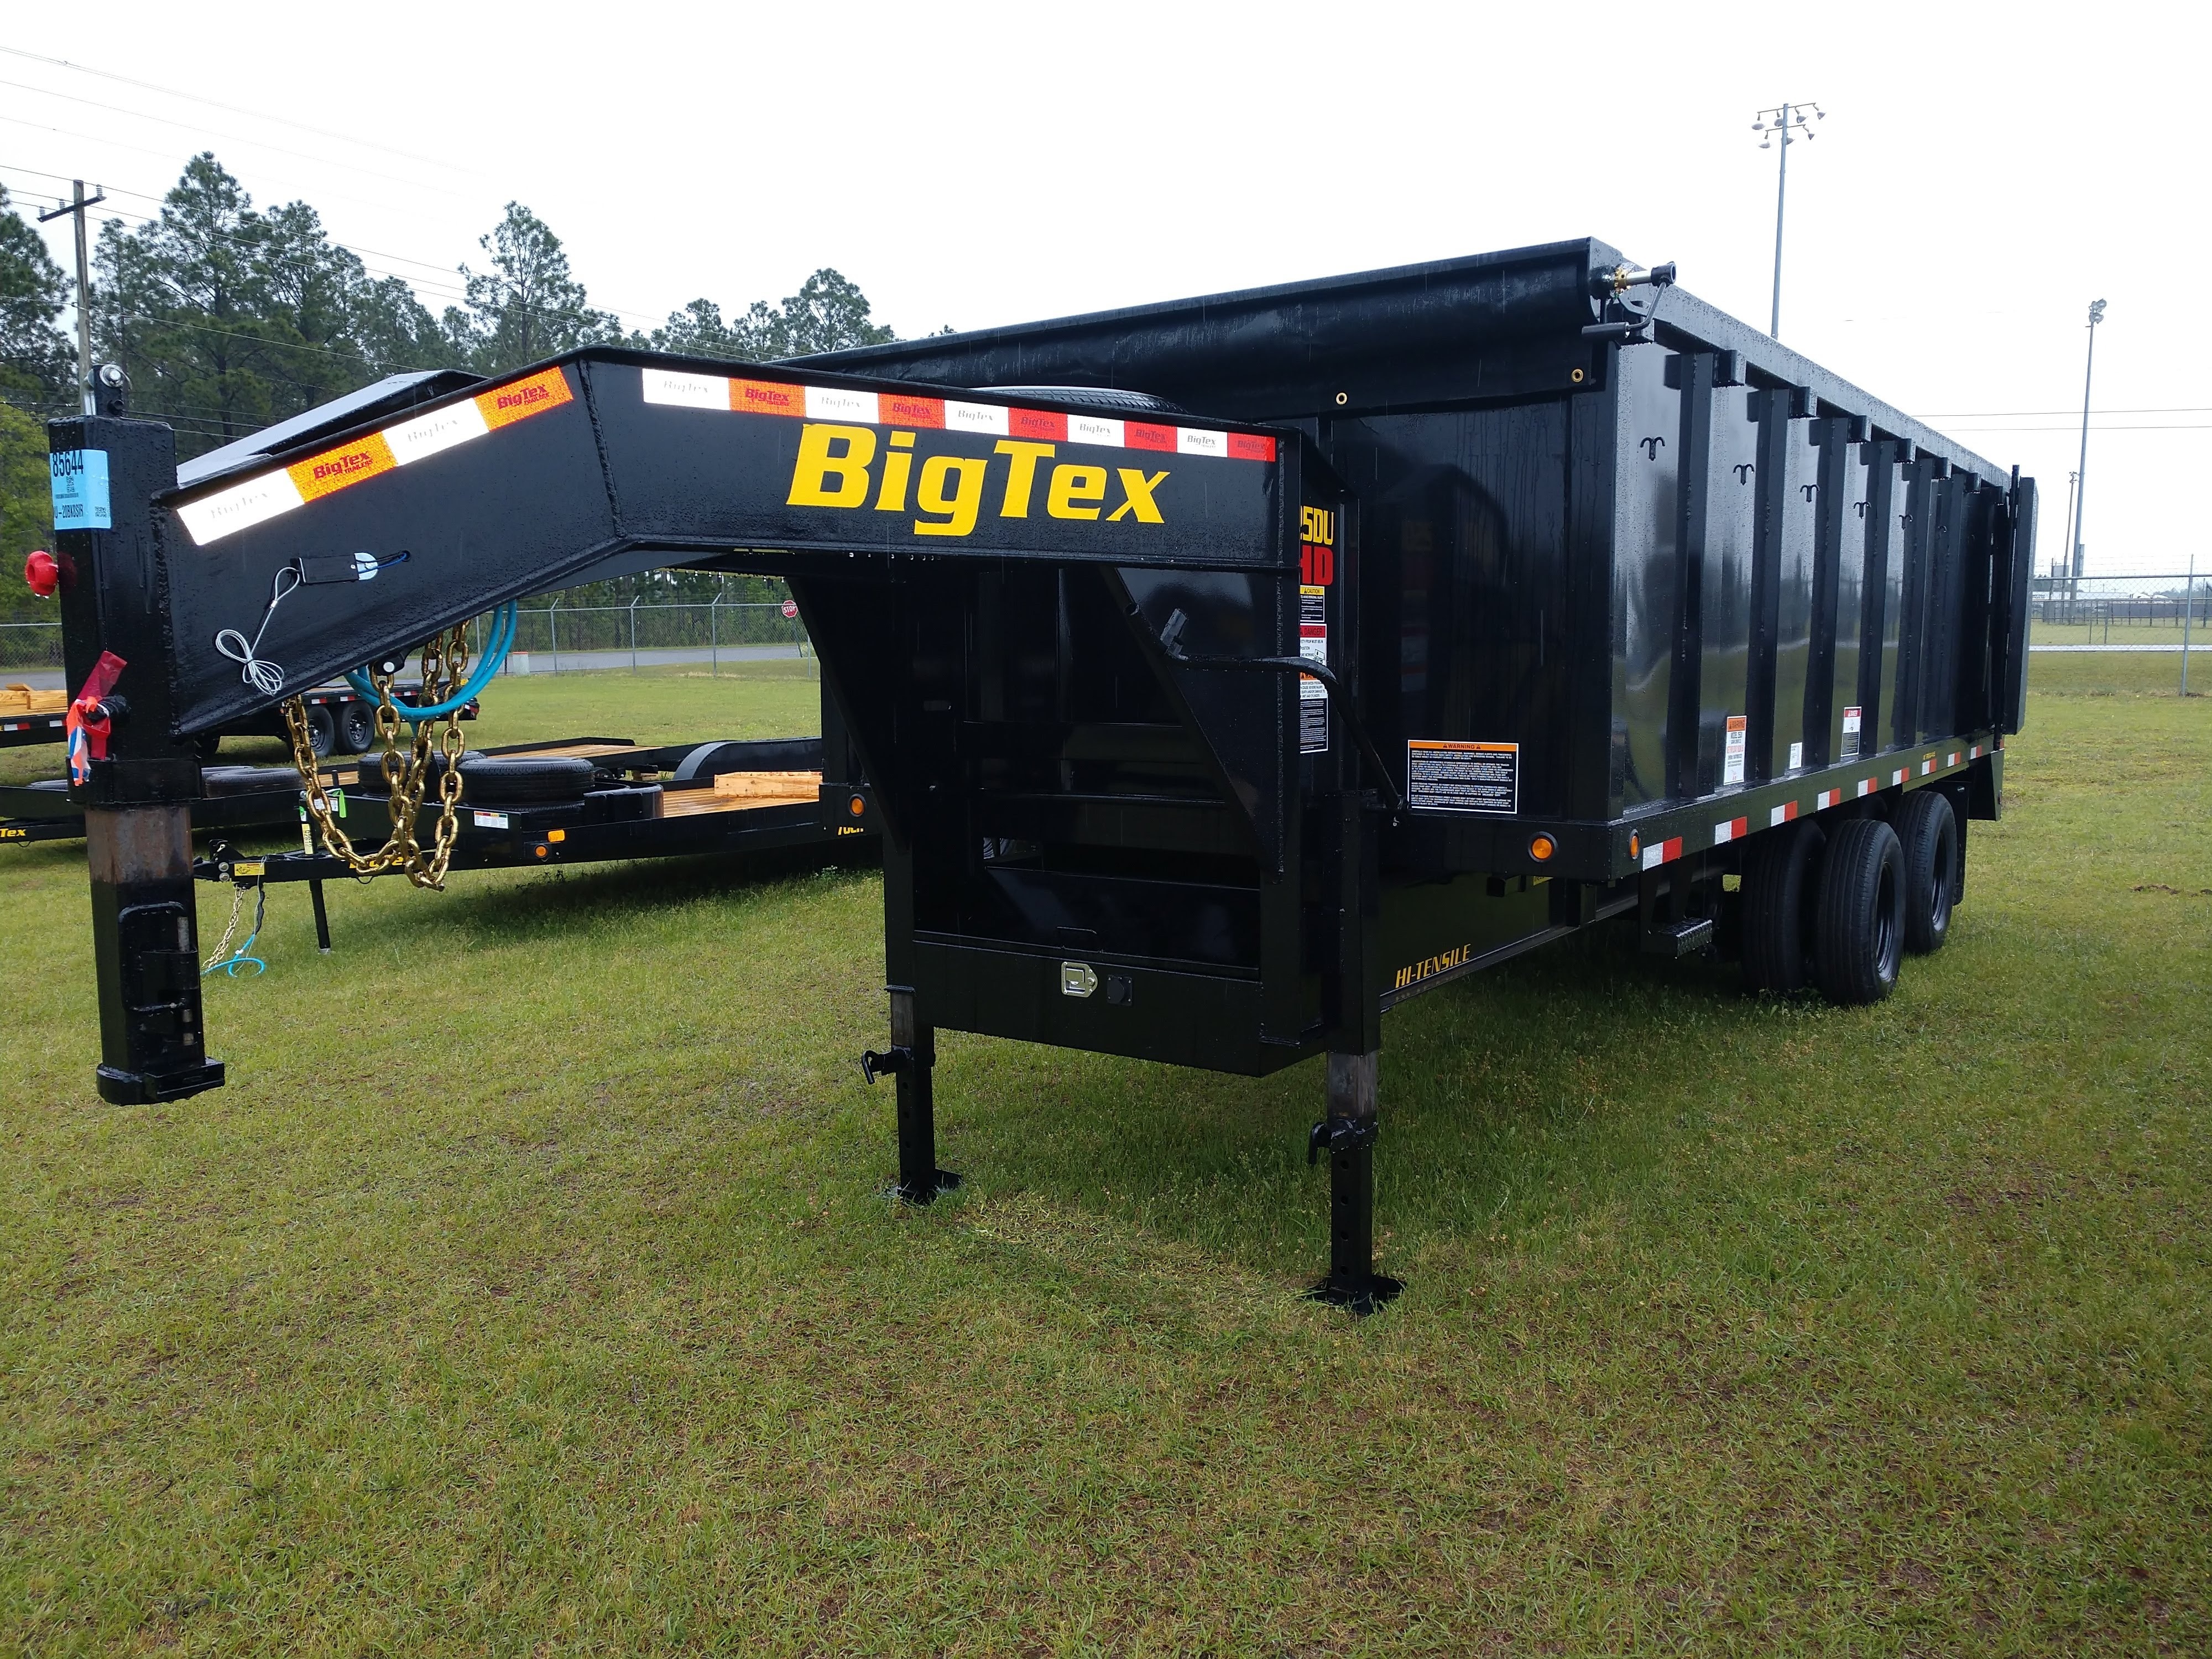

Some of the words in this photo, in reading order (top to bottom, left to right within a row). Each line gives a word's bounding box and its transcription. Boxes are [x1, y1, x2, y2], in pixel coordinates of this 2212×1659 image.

[498, 384, 547, 410] BigTex
[745, 388, 789, 403] BigTex
[892, 403, 930, 416] BigTex
[1021, 416, 1055, 428] BigTex
[1187, 435, 1217, 445] BigTex
[53, 450, 84, 477] 85644
[313, 450, 372, 480] BigTex
[786, 423, 1170, 536] BigTex
[1395, 943, 1471, 988] HI-TENSILE
